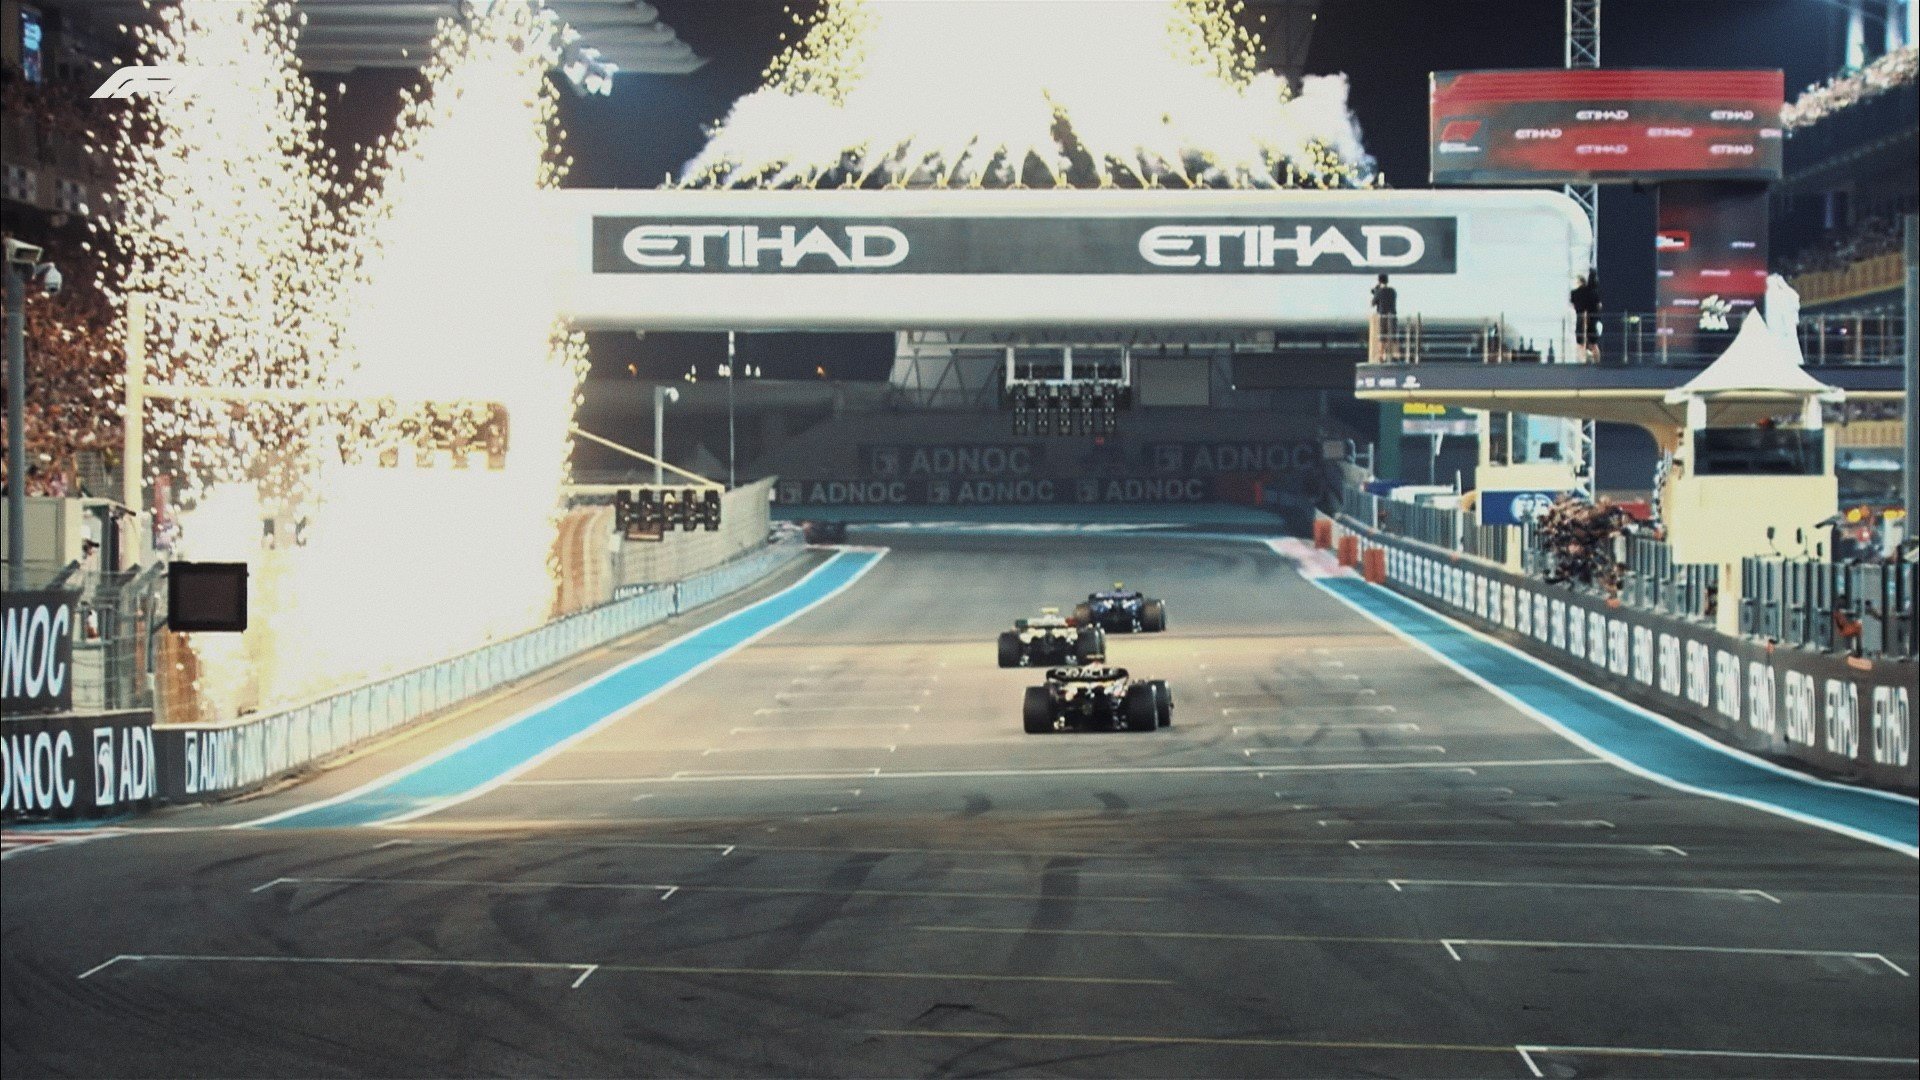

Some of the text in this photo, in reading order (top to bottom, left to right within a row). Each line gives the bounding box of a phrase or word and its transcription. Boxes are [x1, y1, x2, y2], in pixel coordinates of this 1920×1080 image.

[1576, 109, 1629, 120] ETIHAD
[623, 225, 1425, 267] ETIHAD ETIHAD
[910, 448, 1031, 473] ADNOC
[1192, 446, 1314, 471] ADNOC
[810, 479, 1203, 503] ADNOC ADNOC ADNOC
[1, 603, 70, 698] NOC
